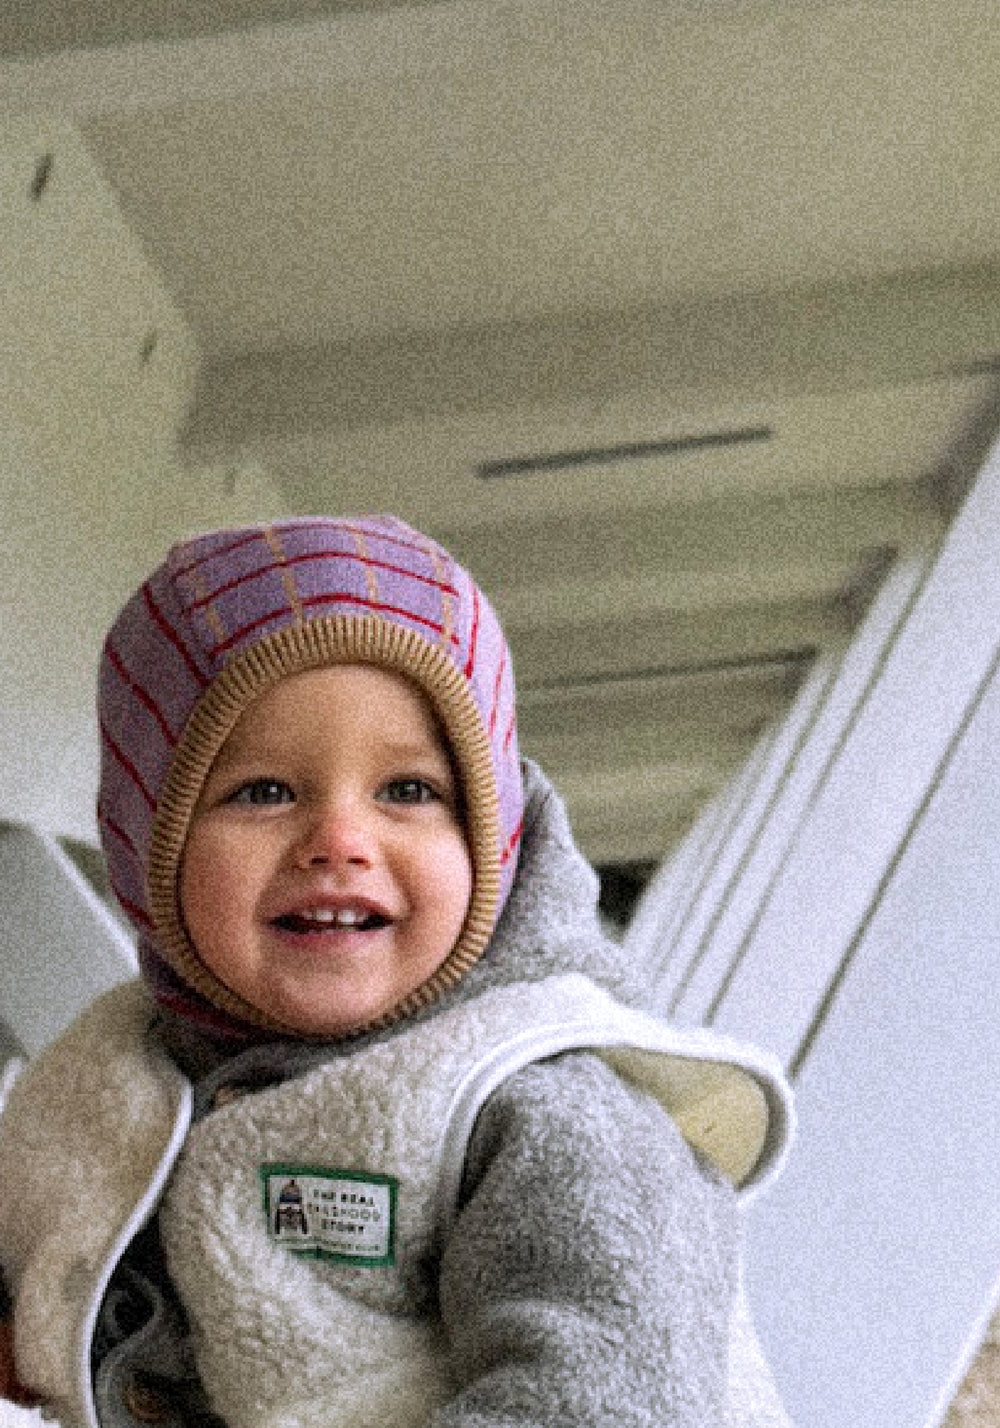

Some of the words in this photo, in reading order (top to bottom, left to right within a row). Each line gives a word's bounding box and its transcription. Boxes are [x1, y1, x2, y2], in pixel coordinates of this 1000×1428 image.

[313, 1189, 337, 1202] THE
[340, 1193, 375, 1207] REAL
[321, 1218, 364, 1234] STORY
